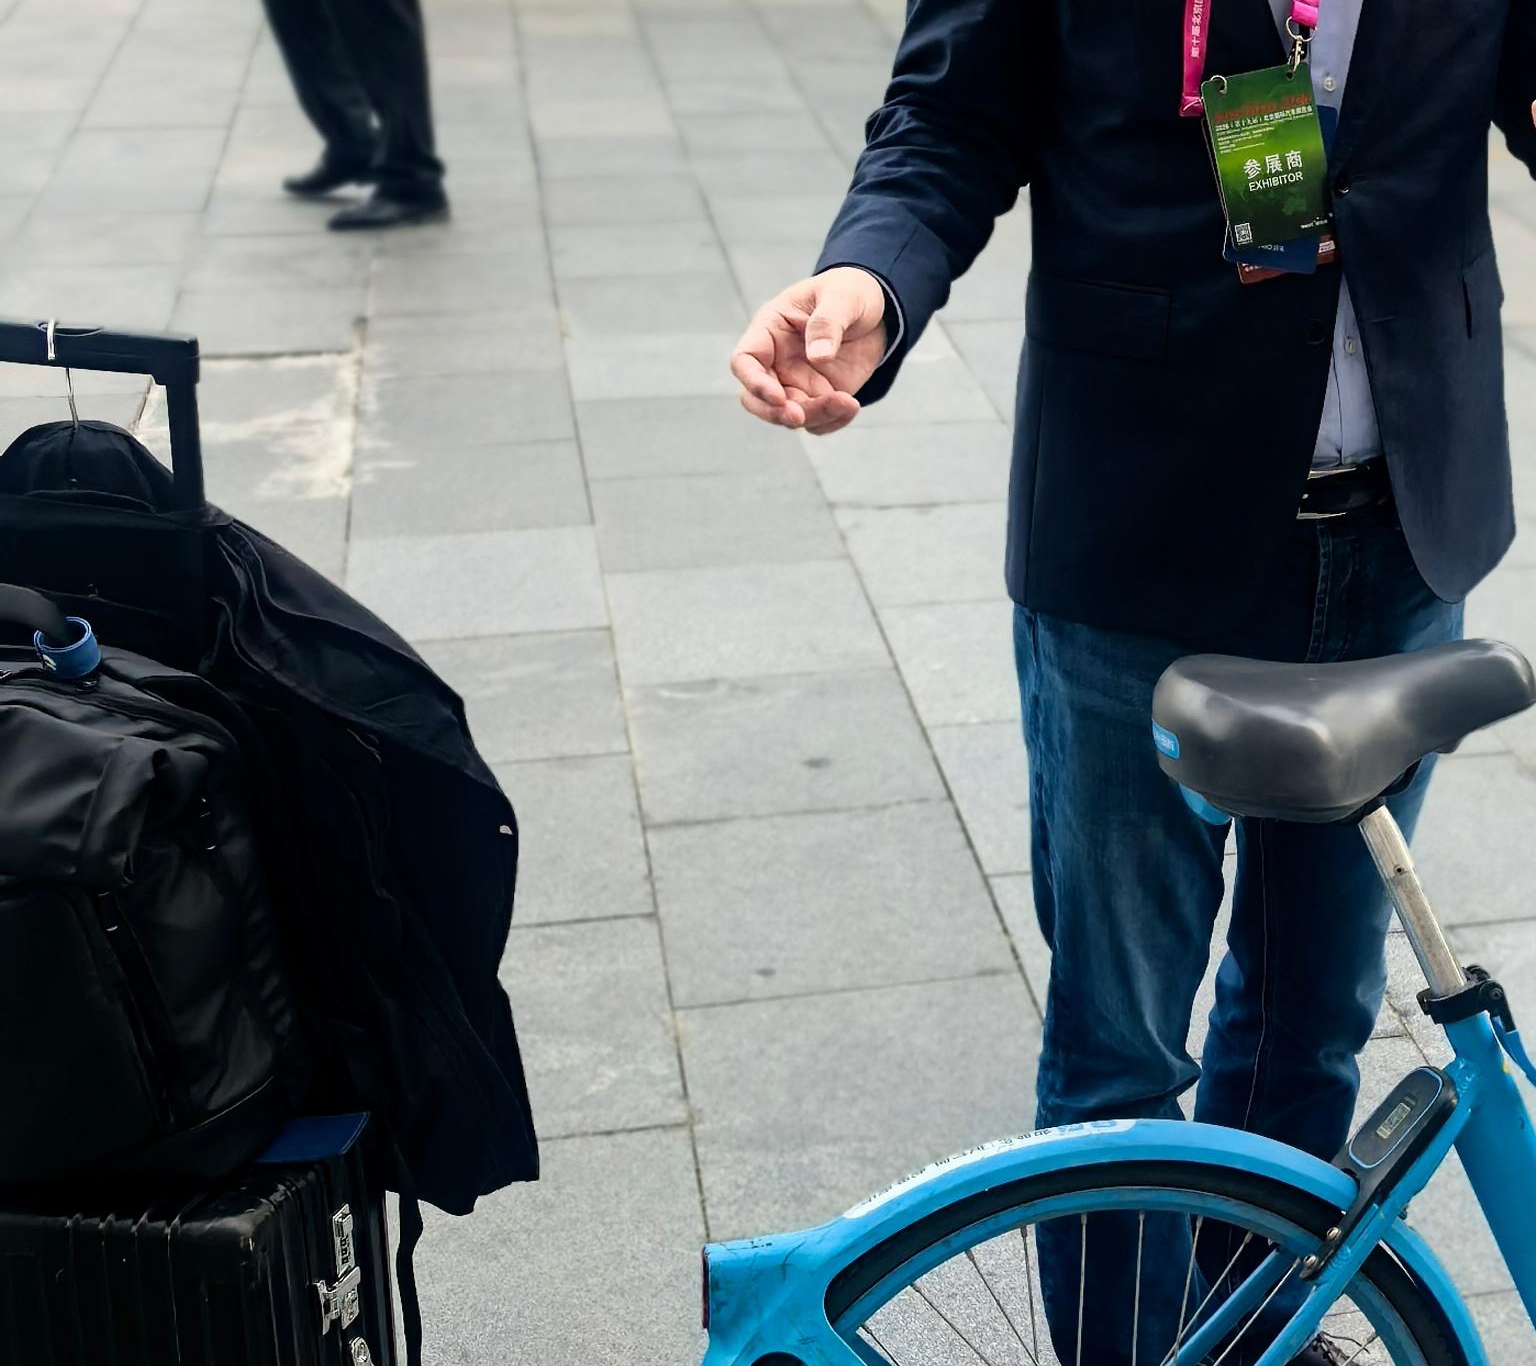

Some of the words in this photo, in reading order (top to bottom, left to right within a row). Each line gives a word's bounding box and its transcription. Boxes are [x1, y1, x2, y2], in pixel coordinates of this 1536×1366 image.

[1243, 150, 1303, 180] 参展商
[1248, 171, 1304, 192] EXHIBITOR
